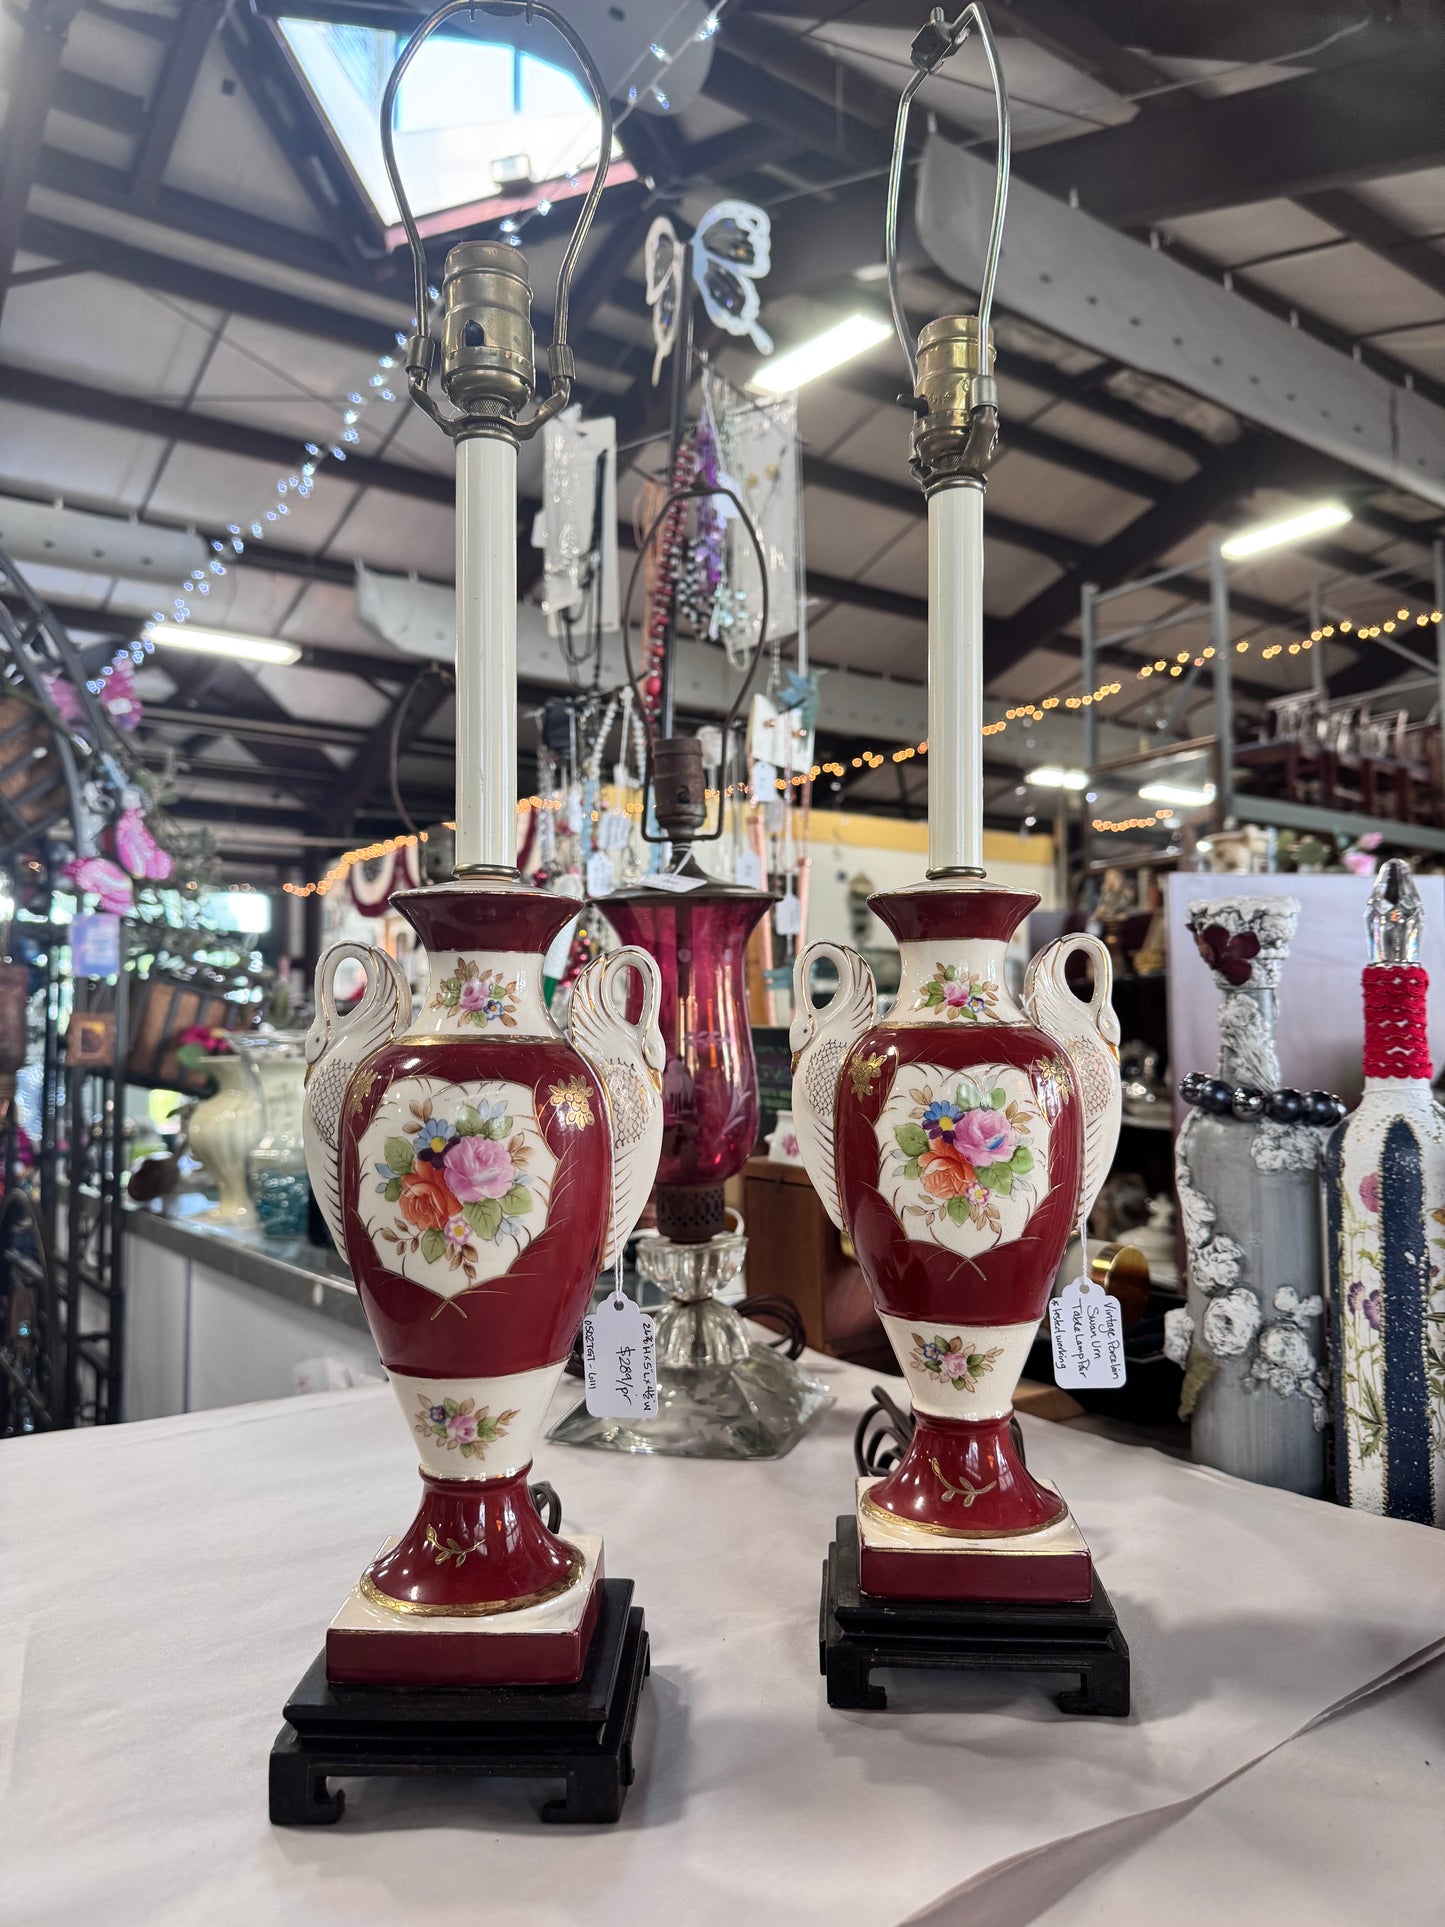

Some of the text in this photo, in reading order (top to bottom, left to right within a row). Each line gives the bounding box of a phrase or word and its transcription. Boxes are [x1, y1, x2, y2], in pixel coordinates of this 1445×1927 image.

[1072, 1298, 1084, 1333] Table
[1086, 1305, 1101, 1360] Swan Urn
[1055, 1335, 1067, 1369] working
[1071, 1333, 1084, 1359] Lamp
[1098, 1302, 1121, 1380] Vintage Porcelain
